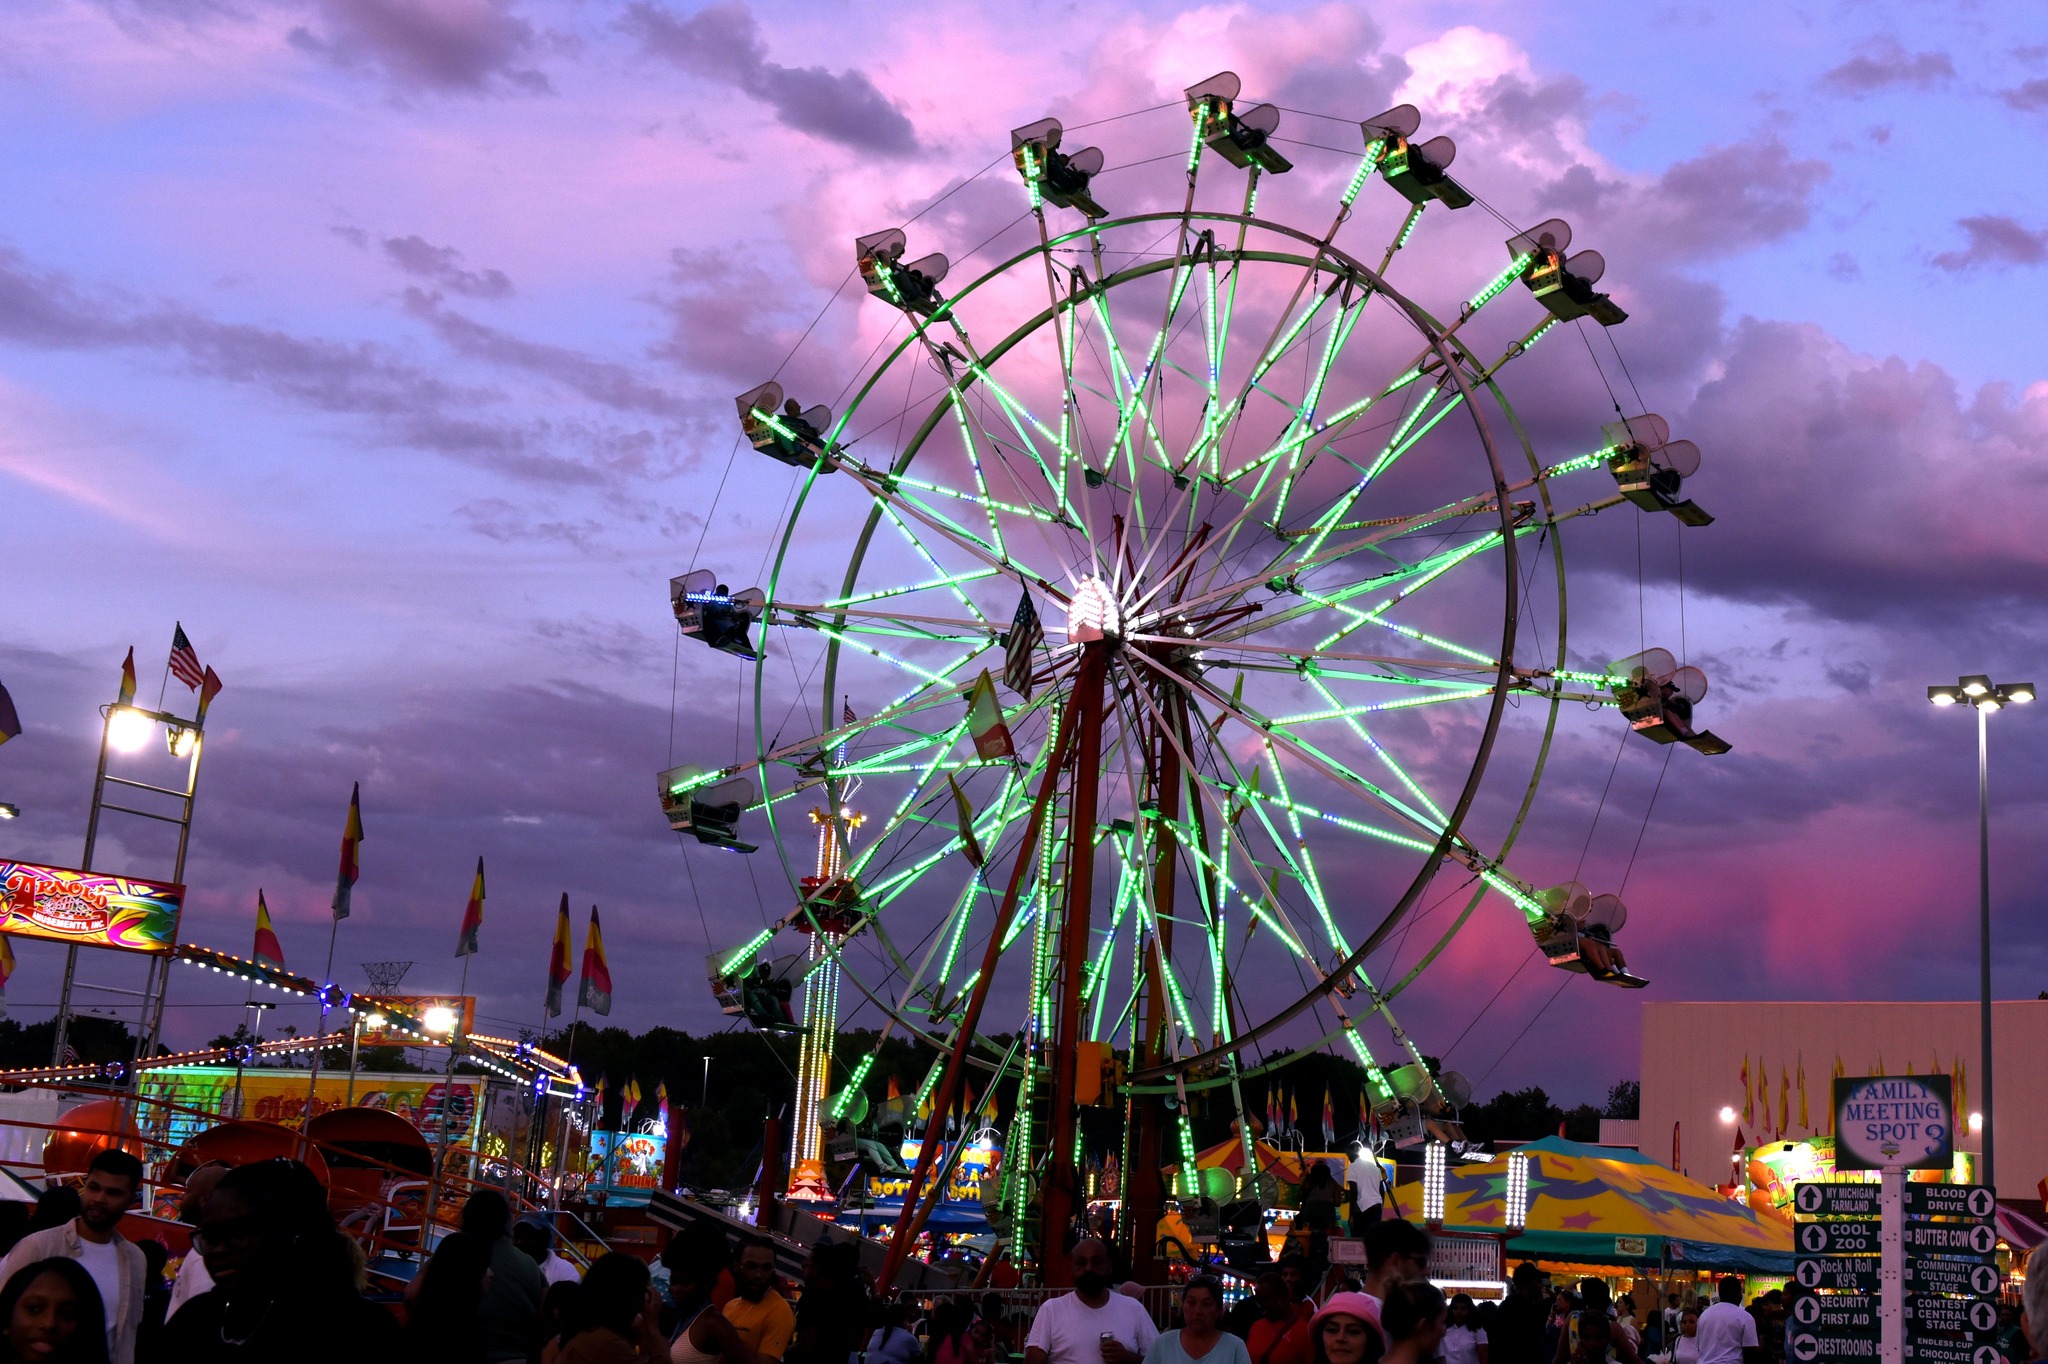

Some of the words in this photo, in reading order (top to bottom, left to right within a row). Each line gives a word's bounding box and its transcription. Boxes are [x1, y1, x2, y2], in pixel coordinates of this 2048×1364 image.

[5, 875, 108, 914] ARNOLD
[32, 911, 89, 931] AMUSEMENTS,
[91, 920, 105, 930] INC.
[1852, 1081, 1931, 1100] FAMILY
[1846, 1102, 1940, 1121] MEETING
[1866, 1123, 1920, 1141] SPOT
[1925, 1124, 1947, 1158] 3
[1826, 1188, 1837, 1199] MY
[1838, 1187, 1874, 1199] MICHIGAN
[1926, 1187, 1967, 1198] BLOOD
[1831, 1200, 1869, 1212] FARMLAND
[1928, 1200, 1964, 1211] DRIVE
[1830, 1224, 1871, 1235] COOL
[1835, 1238, 1867, 1249] ZOO
[1915, 1228, 1947, 1247] BUTTER
[1949, 1230, 1969, 1247] COW
[1821, 1259, 1842, 1273] Rock
[1845, 1259, 1853, 1272] N
[1855, 1259, 1872, 1272] Roll
[1917, 1260, 1973, 1273] COMMUNITY
[1836, 1273, 1857, 1287] K9'S
[1920, 1271, 1968, 1283] CULTURAL
[1929, 1281, 1959, 1293] STAGE
[1820, 1297, 1870, 1308] SECURITY
[1917, 1299, 1968, 1310] CONTEST
[1821, 1314, 1850, 1325] FIRST
[1852, 1314, 1870, 1325] AID
[1918, 1309, 1968, 1320] CENTRAL
[1926, 1320, 1961, 1330] STAGE
[1818, 1337, 1873, 1356] RESTROOMS
[1917, 1337, 1954, 1347] ENDLESS
[1955, 1340, 1973, 1349] CUP
[1919, 1349, 1971, 1362] CHOCOLATE
